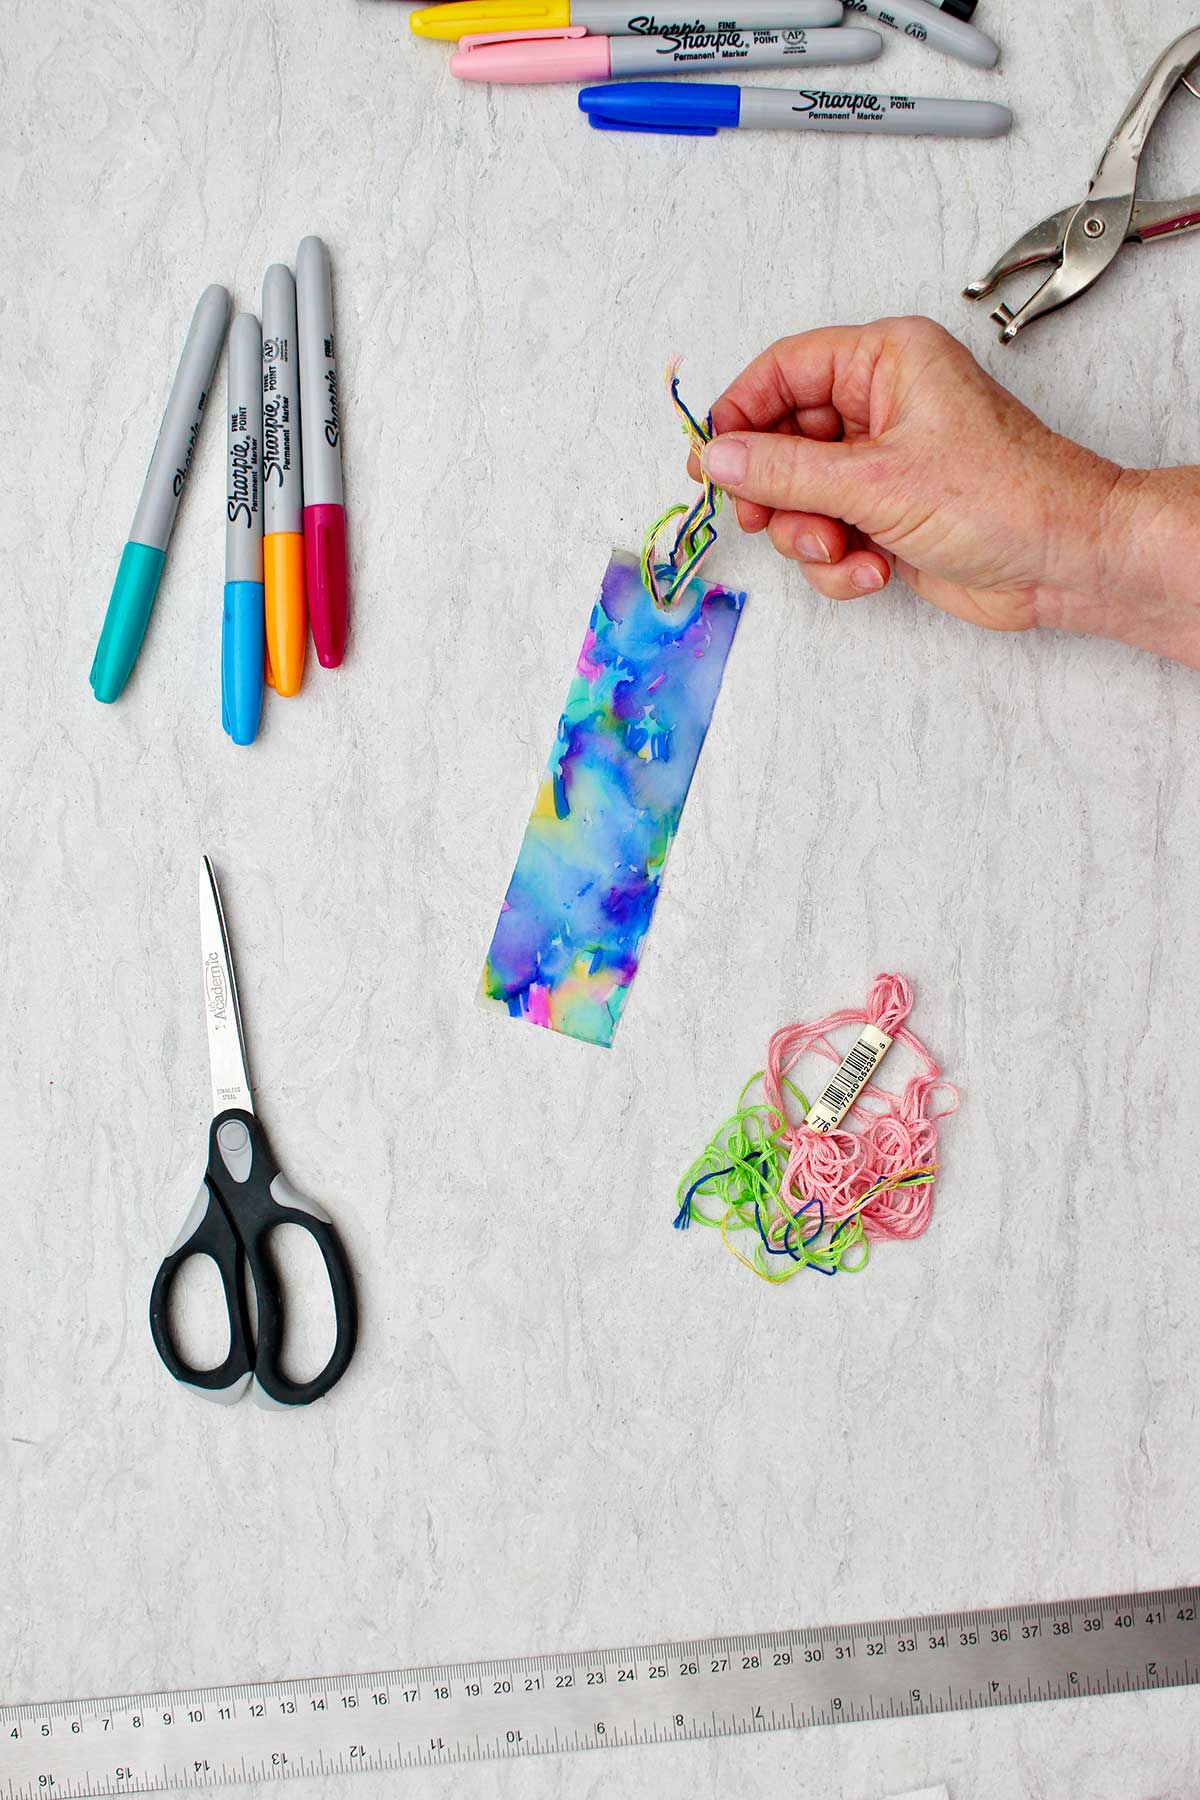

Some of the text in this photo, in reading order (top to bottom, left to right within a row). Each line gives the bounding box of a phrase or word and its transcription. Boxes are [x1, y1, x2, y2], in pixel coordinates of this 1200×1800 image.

[718, 21, 737, 30] FINE
[656, 30, 744, 54] Sharpie
[753, 36, 778, 44] POINT
[674, 50, 748, 61] Permanent Marker
[792, 90, 881, 114] Sharpie
[890, 101, 916, 110] POINT
[808, 111, 883, 121] Permanent Marker
[269, 365, 277, 391] POINT
[239, 406, 247, 431] POINT
[263, 400, 284, 488] Sharpie
[227, 440, 253, 529] Sharpie
[209, 952, 227, 1020] Academic
[840, 1083, 860, 1108] 77540
[858, 1057, 877, 1082] 05229
[878, 1042, 886, 1050] 5
[812, 1116, 831, 1133] 776
[10, 1609, 1194, 1739] 4 5 6 7 8 9 10 11 12 13 14 15 16 17 18 19 20 21 22 23 24 25 26 27 28 29 30 31 32 33 34 35 36 37 38 39 40 41 42
[1148, 1663, 1157, 1675] 2
[1069, 1672, 1078, 1684] 3
[991, 1681, 1000, 1692] 4
[911, 1689, 921, 1701] 5
[755, 1706, 764, 1718] 7
[675, 1714, 684, 1726] 8
[506, 1731, 523, 1743] 10
[430, 1738, 445, 1750] 11
[349, 1745, 367, 1757] 12
[271, 1753, 289, 1765] 13
[194, 1760, 211, 1771] 14
[115, 1767, 133, 1779] 15
[38, 1774, 56, 1787] 16
